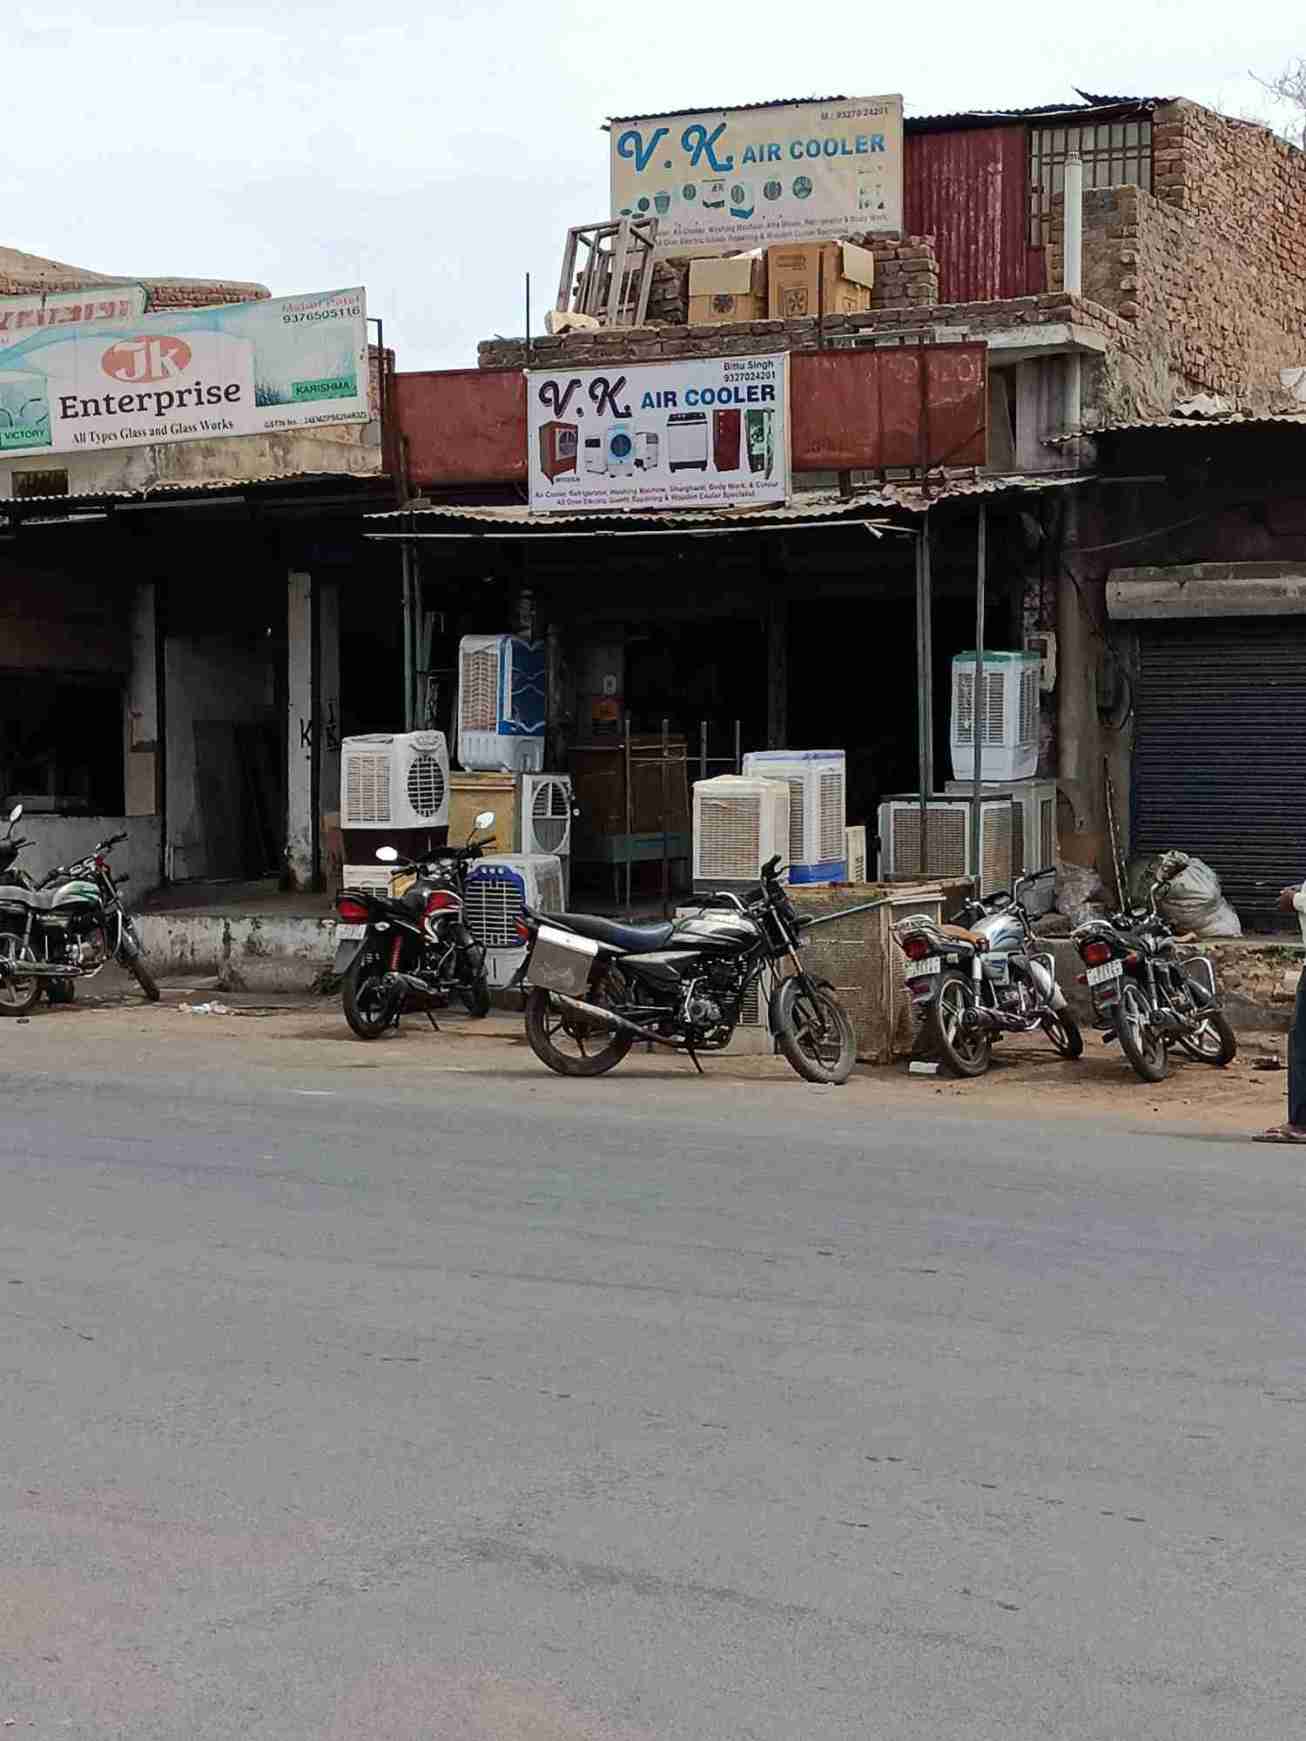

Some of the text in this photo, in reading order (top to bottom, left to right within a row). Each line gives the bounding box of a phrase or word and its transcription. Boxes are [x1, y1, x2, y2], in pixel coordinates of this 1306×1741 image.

[742, 142, 782, 165] AIR
[789, 132, 886, 159] COOLER
[747, 359, 774, 371] Singh
[58, 380, 241, 420] Enterprise
[295, 381, 350, 396] KARISHMA
[641, 391, 678, 410] AIR
[684, 383, 776, 407] COOLER
[72, 417, 234, 444] All Types Glass and Glass Works
